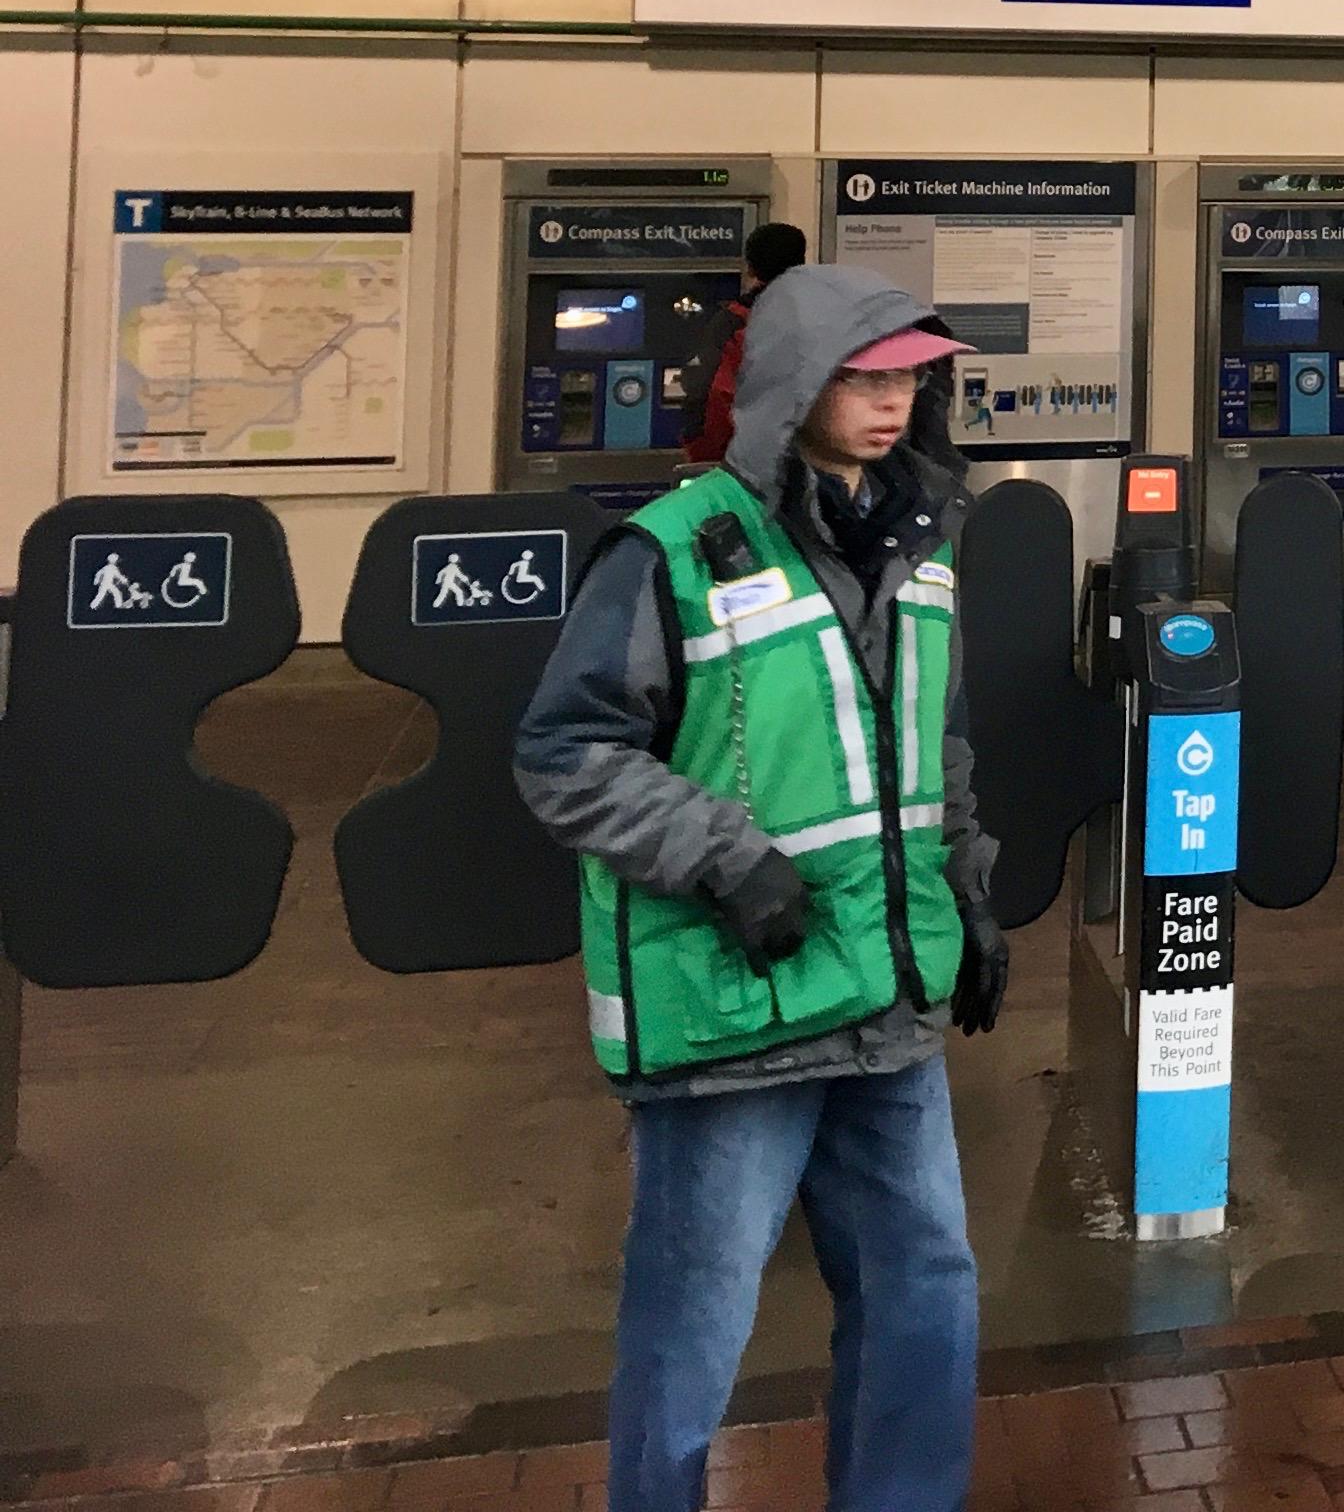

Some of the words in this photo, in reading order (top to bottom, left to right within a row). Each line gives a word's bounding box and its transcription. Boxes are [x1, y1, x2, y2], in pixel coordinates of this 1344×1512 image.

[882, 181, 910, 195] Exit
[915, 181, 957, 196] Ticket
[962, 181, 1023, 196] Machine
[1028, 182, 1110, 197] Information
[569, 226, 640, 242] Compass
[645, 226, 675, 239] Exit
[678, 226, 734, 240] Tickets
[1256, 227, 1317, 243] Compass
[1172, 790, 1216, 822] Tap
[1181, 824, 1205, 850] In
[1164, 892, 1218, 916] Fare
[1162, 916, 1218, 944] Paid
[1157, 949, 1221, 972] Zone
[1152, 1008, 1188, 1024] Valid
[1194, 1007, 1222, 1021] Fare
[1155, 1025, 1219, 1042] Required
[1160, 1044, 1213, 1060] Beyond
[1150, 1063, 1180, 1077] This
[1185, 1060, 1221, 1075] Point
